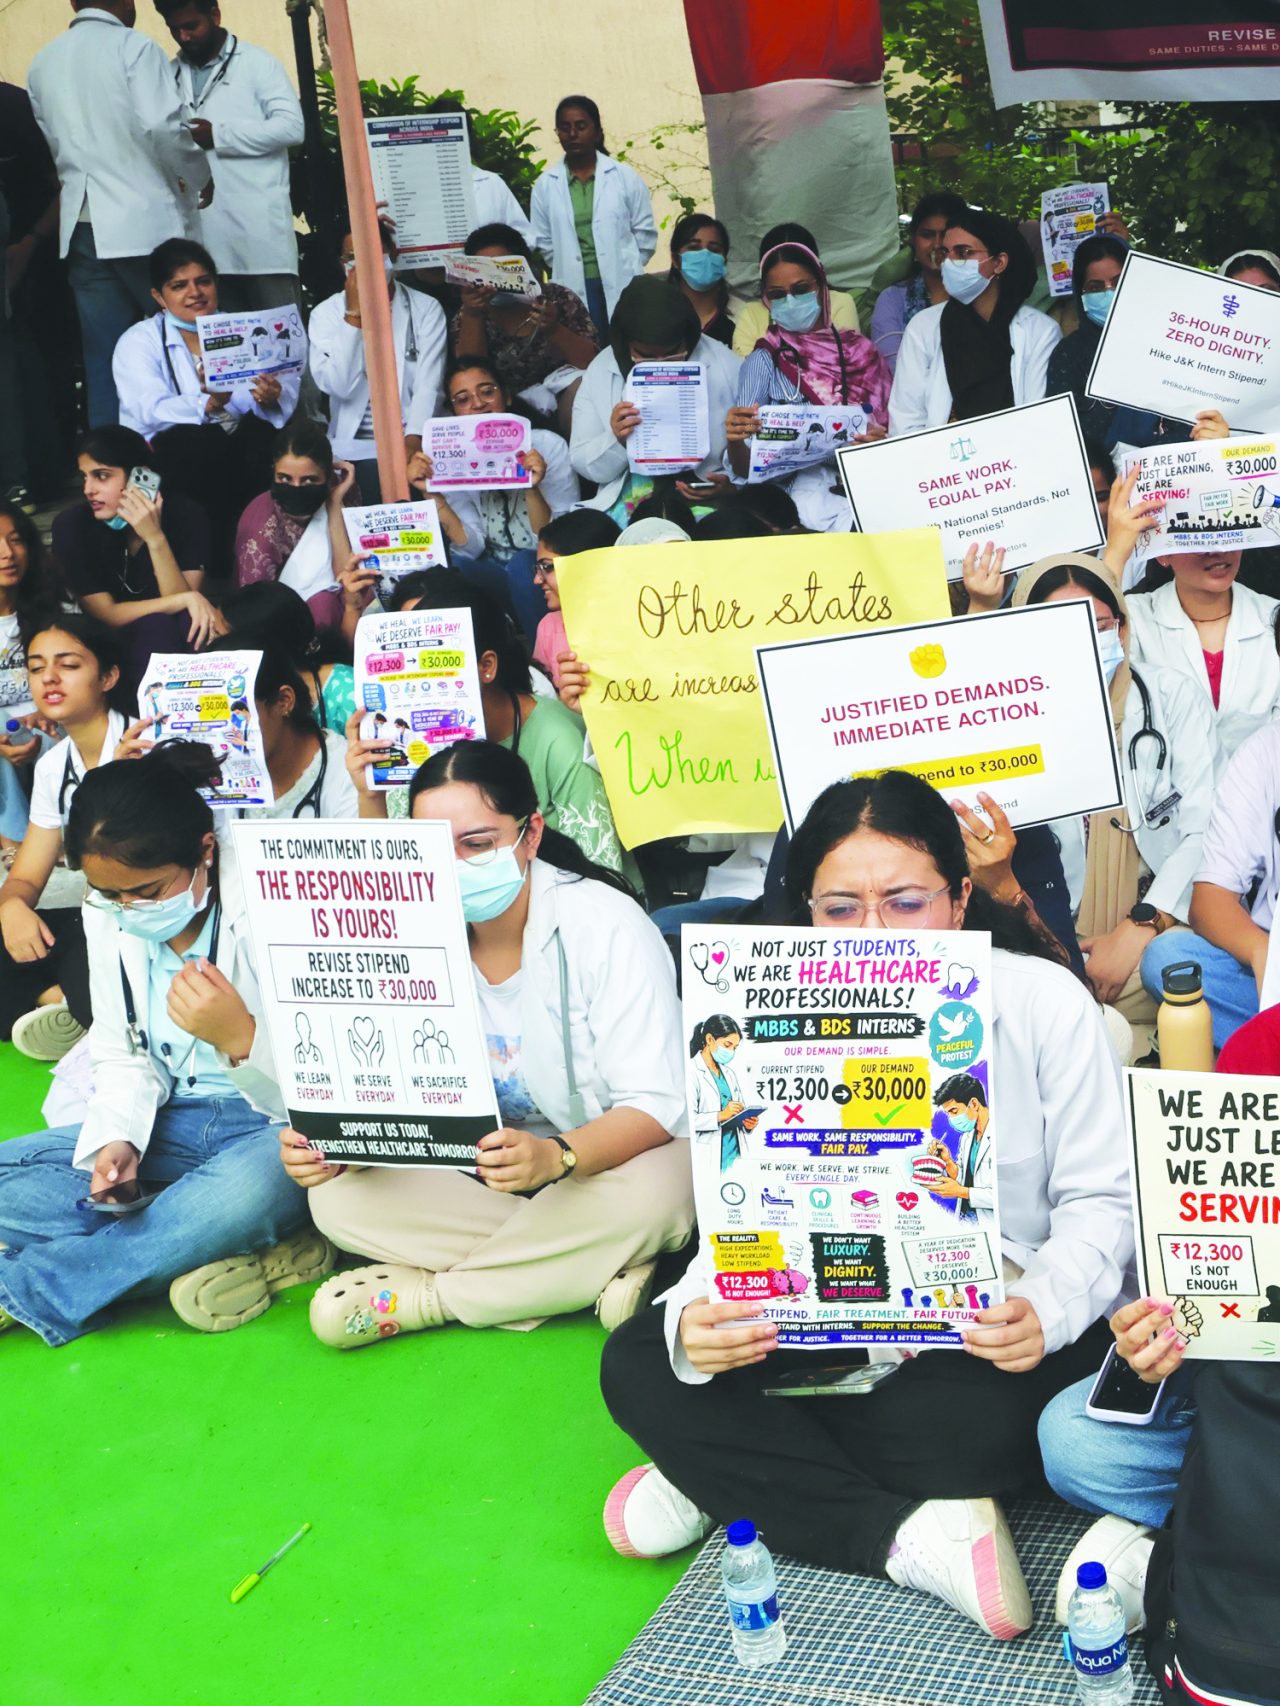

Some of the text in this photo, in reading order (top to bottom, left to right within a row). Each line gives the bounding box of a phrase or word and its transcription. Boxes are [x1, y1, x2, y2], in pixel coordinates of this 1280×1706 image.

[1208, 29, 1276, 41] REVISE
[1149, 47, 1180, 55] SAME
[1185, 45, 1225, 53] DUTIES
[1236, 44, 1268, 52] SAME
[1169, 311, 1271, 349] 36-HOUR DUTY.
[1166, 328, 1264, 365] ZERO DIGNITY.
[1149, 348, 1267, 386] Hike J&K Intern Stipend!
[918, 459, 1017, 493] SAME WORK.
[928, 477, 1016, 509] EQUAL PAY.
[944, 509, 989, 530] National
[991, 495, 1050, 517] Standards,
[1051, 487, 1070, 500] Not
[958, 520, 1005, 539] Pennies!
[638, 571, 893, 639] Other states
[375, 623, 461, 643] WE DESERVE FAIR PAY!
[601, 672, 759, 704] are increas
[821, 675, 1050, 724] JUSTIFIED DEMANDS.
[833, 701, 1045, 746] IMMEDIATE ACTION.
[615, 730, 738, 795] When
[917, 752, 1038, 781] pend to ₹30,000
[261, 839, 423, 863] THE COMMITMENT IS OURS,
[256, 869, 436, 902] THE RESPONSIBILITY
[311, 908, 399, 939] IS YOURS!
[308, 951, 410, 974] REVISE STIPEND
[751, 940, 920, 960] NOT JUST STUDENTS,
[733, 959, 942, 985] WE ARE HEALTHCARE
[291, 977, 437, 1003] INCREASE TO ₹30,000
[745, 986, 915, 1011] PROFESSIONALS!
[754, 1018, 916, 1037] MBBS & BDS INTERNS
[756, 1076, 830, 1103] ₹12,300
[851, 1076, 927, 1103] ₹30,000
[1157, 1088, 1204, 1120] WE
[1218, 1091, 1280, 1122] ARE
[340, 1122, 433, 1140] SUPPORT US TODAY,
[1166, 1126, 1241, 1154] JUST
[367, 1141, 428, 1157] HEALTHCARE
[1166, 1158, 1276, 1188] WE ARE
[1170, 1242, 1244, 1263] ₹12,300
[1186, 1278, 1239, 1292] ENOUGH
[1191, 1265, 1230, 1278] IS NOT
[1076, 1651, 1111, 1670] Aqua
